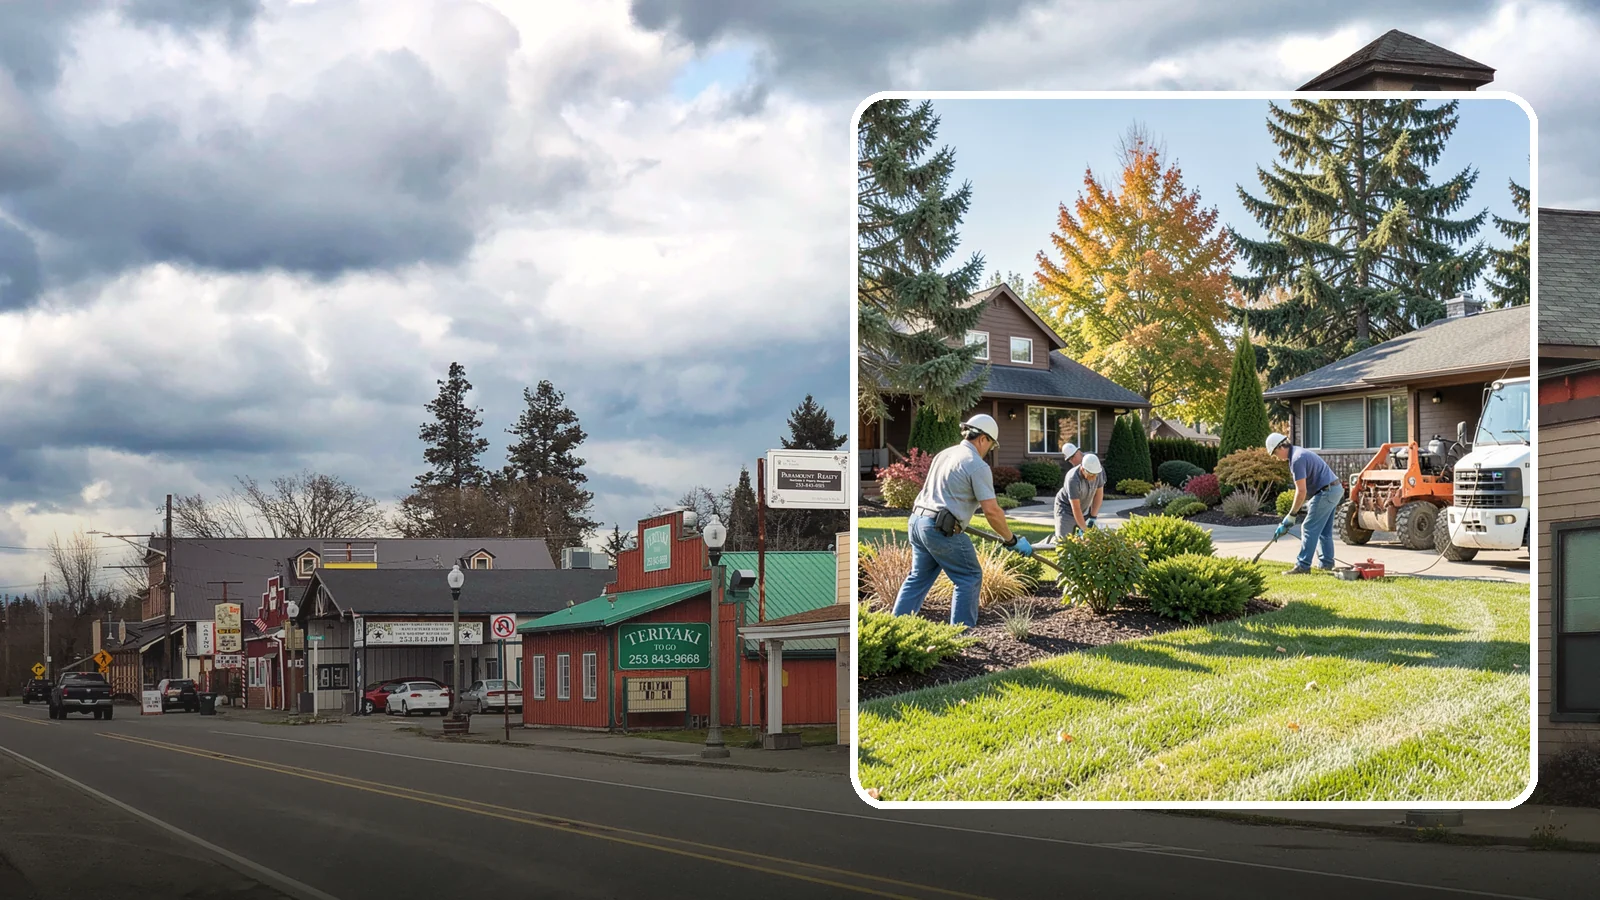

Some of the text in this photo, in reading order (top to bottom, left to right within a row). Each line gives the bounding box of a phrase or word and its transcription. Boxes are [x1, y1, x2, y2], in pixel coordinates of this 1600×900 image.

[625, 628, 702, 646] TERIYAKI
[629, 654, 700, 664] 253 843-9668
